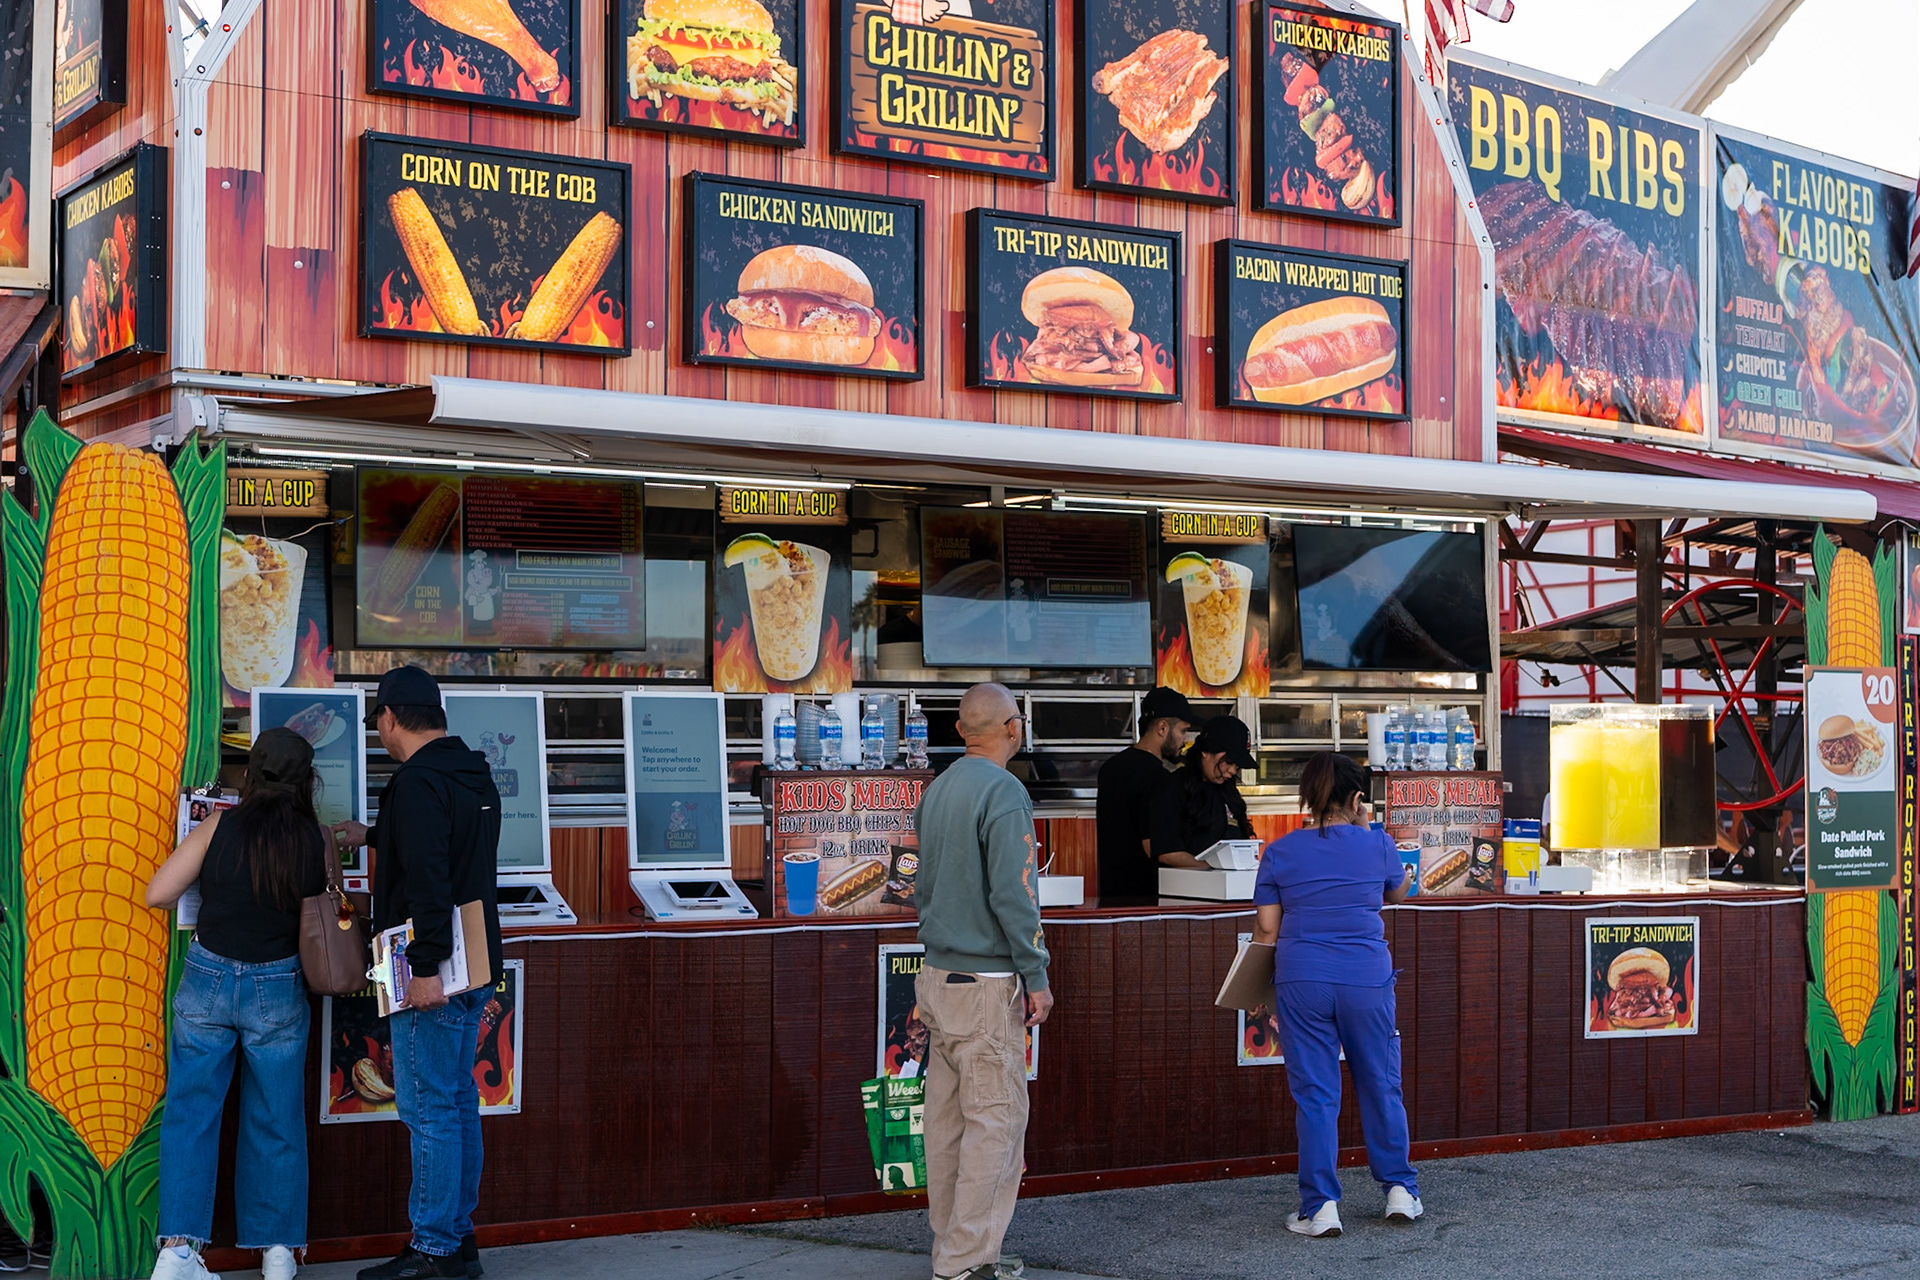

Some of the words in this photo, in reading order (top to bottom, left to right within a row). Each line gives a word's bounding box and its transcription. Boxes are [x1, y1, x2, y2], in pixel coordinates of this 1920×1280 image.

[868, 15, 1007, 83] CHILLIN'
[1012, 53, 1031, 86] &
[1273, 20, 1333, 52] CHICKEN
[1336, 31, 1390, 62] KABOBS
[62, 55, 98, 104] GRILLIN'
[880, 73, 1018, 138] GRILLIN'
[1469, 85, 1562, 203] BBQ
[1586, 116, 1685, 217] RIBS
[401, 153, 462, 187] CORN
[468, 162, 500, 192] ON
[507, 166, 550, 198] THE
[556, 173, 597, 204] COB
[67, 187, 100, 230] CHICKEN
[101, 168, 135, 211] KABOBS
[1772, 160, 1874, 226] FLAVORED
[719, 192, 796, 225] CHICKEN
[801, 202, 895, 237] SANDWICH
[993, 226, 1062, 257] TRI-TIP
[1067, 235, 1169, 270] SANDWICH
[1778, 207, 1871, 275] KABOBS
[1235, 256, 1281, 283] BACON
[1284, 262, 1349, 292] WRAPPED
[1352, 271, 1376, 295] HOT
[1379, 275, 1403, 299] DOG
[1735, 296, 1784, 325] BUFFALO
[1735, 325, 1786, 353] TERIYAKI
[1735, 353, 1787, 381] CHIPOTLE
[1736, 381, 1772, 406] GREEN
[1775, 387, 1803, 411] CHILI
[1737, 409, 1776, 434] MANGO
[1779, 415, 1833, 444] HABANERO
[239, 479, 255, 505] IN
[262, 479, 275, 506] A
[282, 480, 315, 506] CUP
[732, 490, 768, 515] CORN
[775, 491, 789, 515] IN
[794, 491, 806, 516] A
[811, 493, 837, 516] CUP
[1172, 513, 1202, 535] CORN
[1206, 514, 1219, 536] IN
[1223, 515, 1233, 536] A
[1236, 516, 1258, 537] CUP
[414, 599, 426, 609] ON
[427, 599, 441, 609] THE
[415, 585, 440, 598] CORN
[419, 611, 437, 623] COB
[1865, 674, 1895, 706] 20
[1903, 645, 1915, 756] FIRE
[642, 756, 656, 764] Tap
[656, 755, 692, 764] anywhere
[660, 766, 677, 774] your
[780, 779, 847, 812] KIDS
[1391, 779, 1440, 807] KIDS
[1444, 779, 1500, 807] MEAL
[501, 811, 516, 819] rder
[517, 811, 538, 819] here.
[778, 815, 807, 833] HOT
[808, 815, 836, 834] DOG
[837, 814, 863, 835] BBQ
[864, 814, 900, 833] CHIPS
[1390, 810, 1411, 826] HOT
[1412, 810, 1432, 826] DOG
[1433, 810, 1452, 827] BBQ
[1453, 809, 1480, 825] CHIPS
[1481, 808, 1501, 824] AND
[849, 838, 890, 857] DRINK
[1443, 831, 1472, 846] DRINK
[1820, 831, 1839, 843] Date
[1840, 829, 1866, 842] Pulled
[1866, 829, 1886, 841] Pork
[1834, 845, 1873, 858] Sandwich
[1903, 773, 1915, 972] ROASTED
[1592, 927, 1631, 943] TRI-TIP
[1633, 925, 1693, 943] SANDWICH
[1905, 989, 1915, 1102] CORN
[887, 1079, 926, 1097] Weee!
